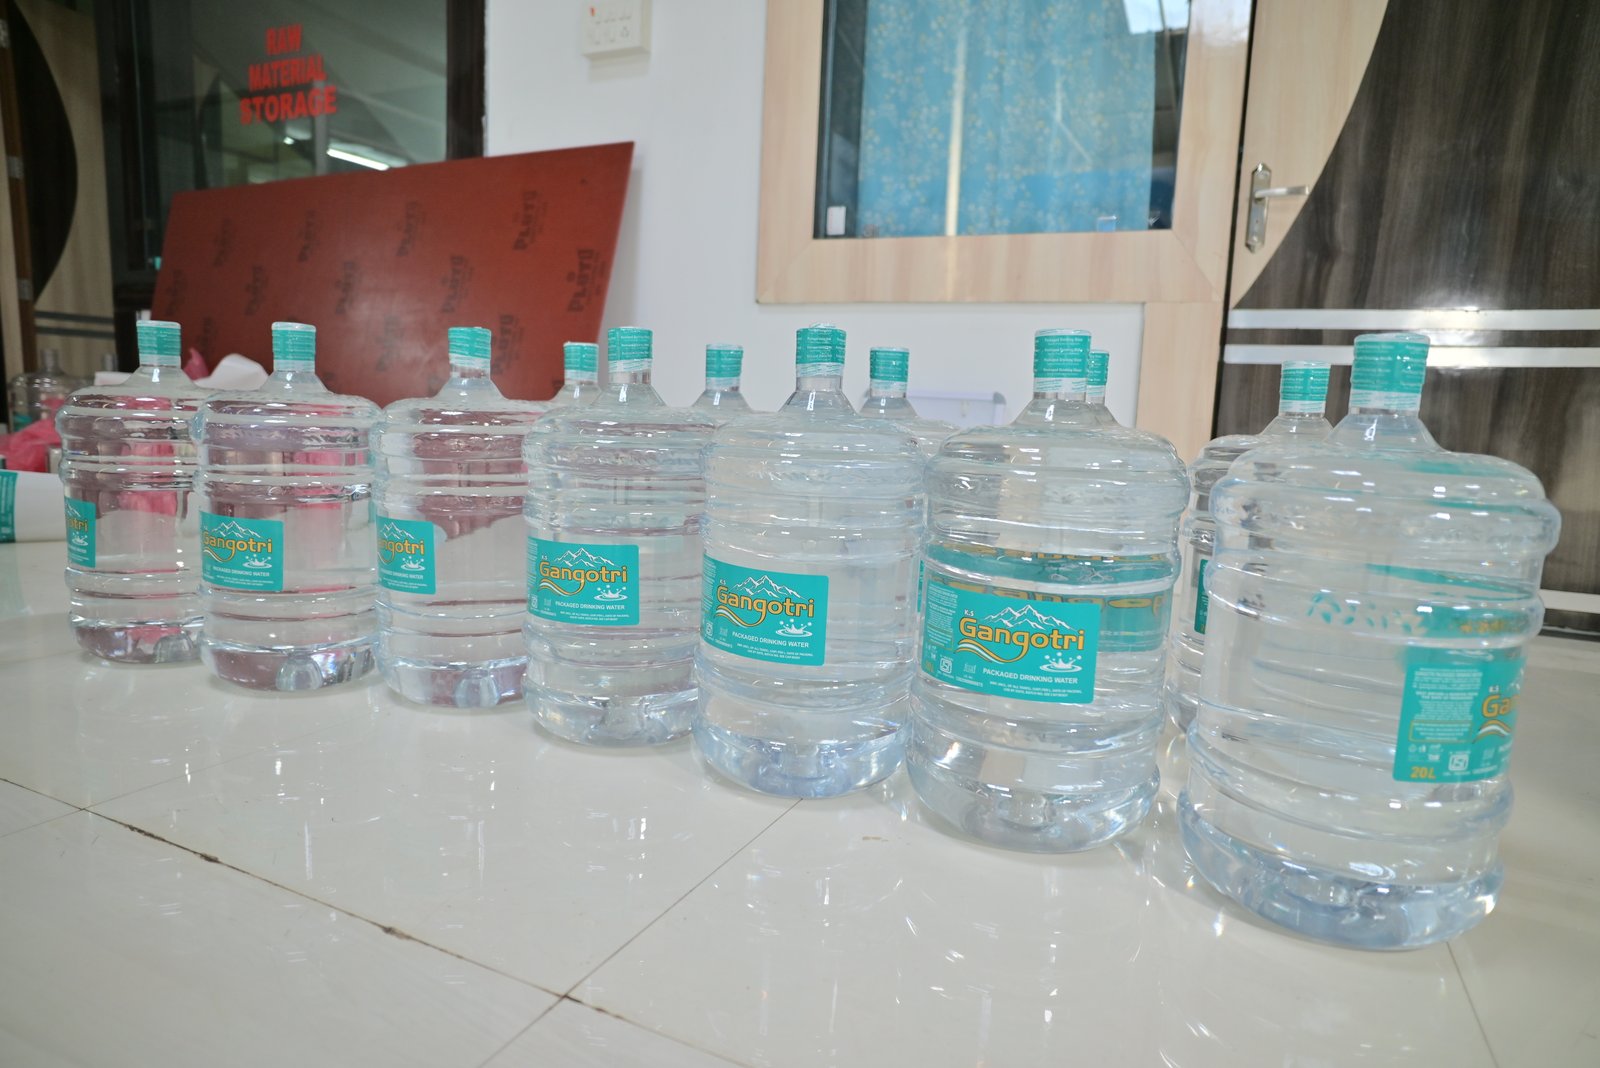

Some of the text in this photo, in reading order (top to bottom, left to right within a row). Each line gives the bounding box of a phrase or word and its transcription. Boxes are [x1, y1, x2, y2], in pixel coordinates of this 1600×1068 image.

[265, 23, 302, 55] RAW
[248, 54, 326, 92] MATERIAL
[240, 85, 337, 125] STORAGE
[539, 560, 629, 588] Gangotri
[716, 584, 816, 623] Gangotri
[732, 631, 759, 642] PACKAGED
[759, 637, 787, 647] DRINKING
[959, 616, 1086, 657] Gangotri
[983, 667, 1079, 685] PACKAGED DRINKING WATER
